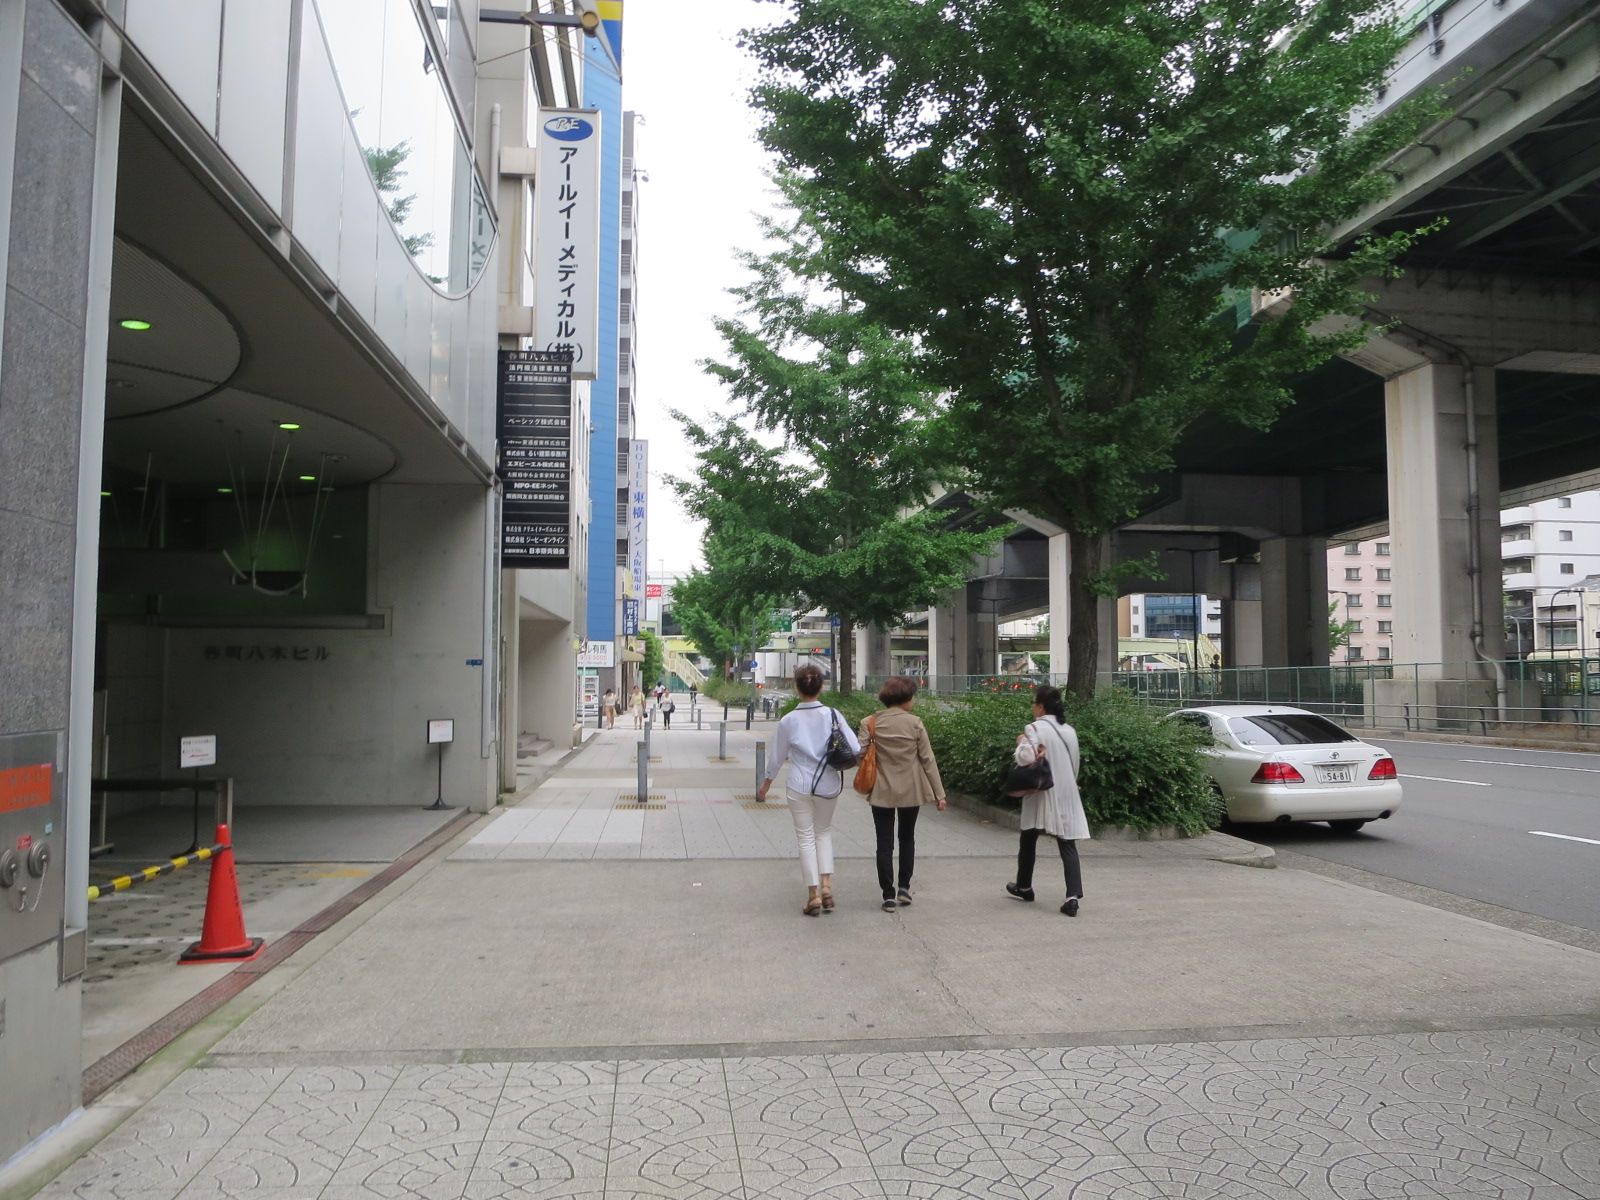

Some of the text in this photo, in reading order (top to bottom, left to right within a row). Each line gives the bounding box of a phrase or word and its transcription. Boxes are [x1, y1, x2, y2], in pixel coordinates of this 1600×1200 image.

[632, 491, 645, 547] 東横イン
[529, 547, 565, 555] 日本協会
